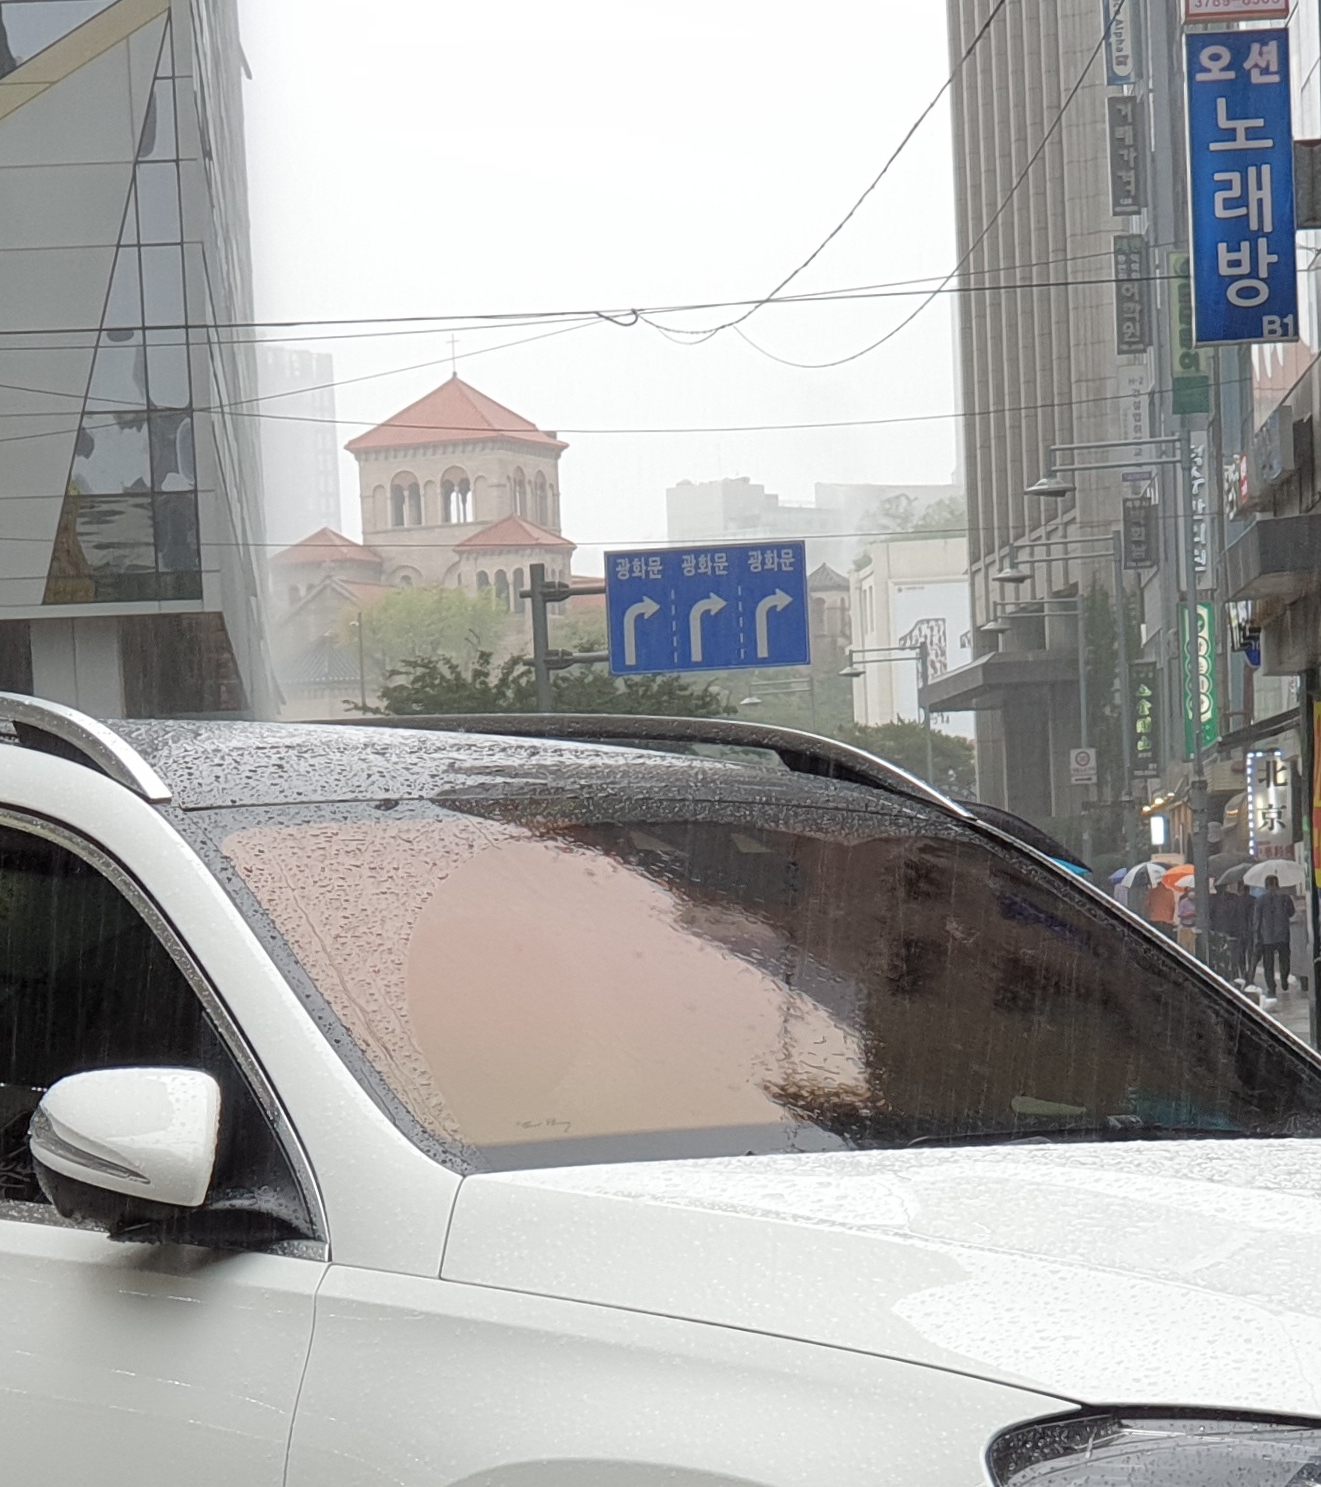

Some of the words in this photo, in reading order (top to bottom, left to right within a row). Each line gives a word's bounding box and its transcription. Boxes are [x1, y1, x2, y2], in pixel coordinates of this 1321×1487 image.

[1115, 19, 1131, 53] Alpha
[1195, 40, 1281, 84] 오션
[1209, 97, 1278, 308] 노래방
[1262, 314, 1297, 339] B1
[615, 556, 663, 580] 광화문
[681, 552, 728, 577] 광화문
[747, 548, 795, 573] 광화문
[1258, 760, 1288, 832] 北京
